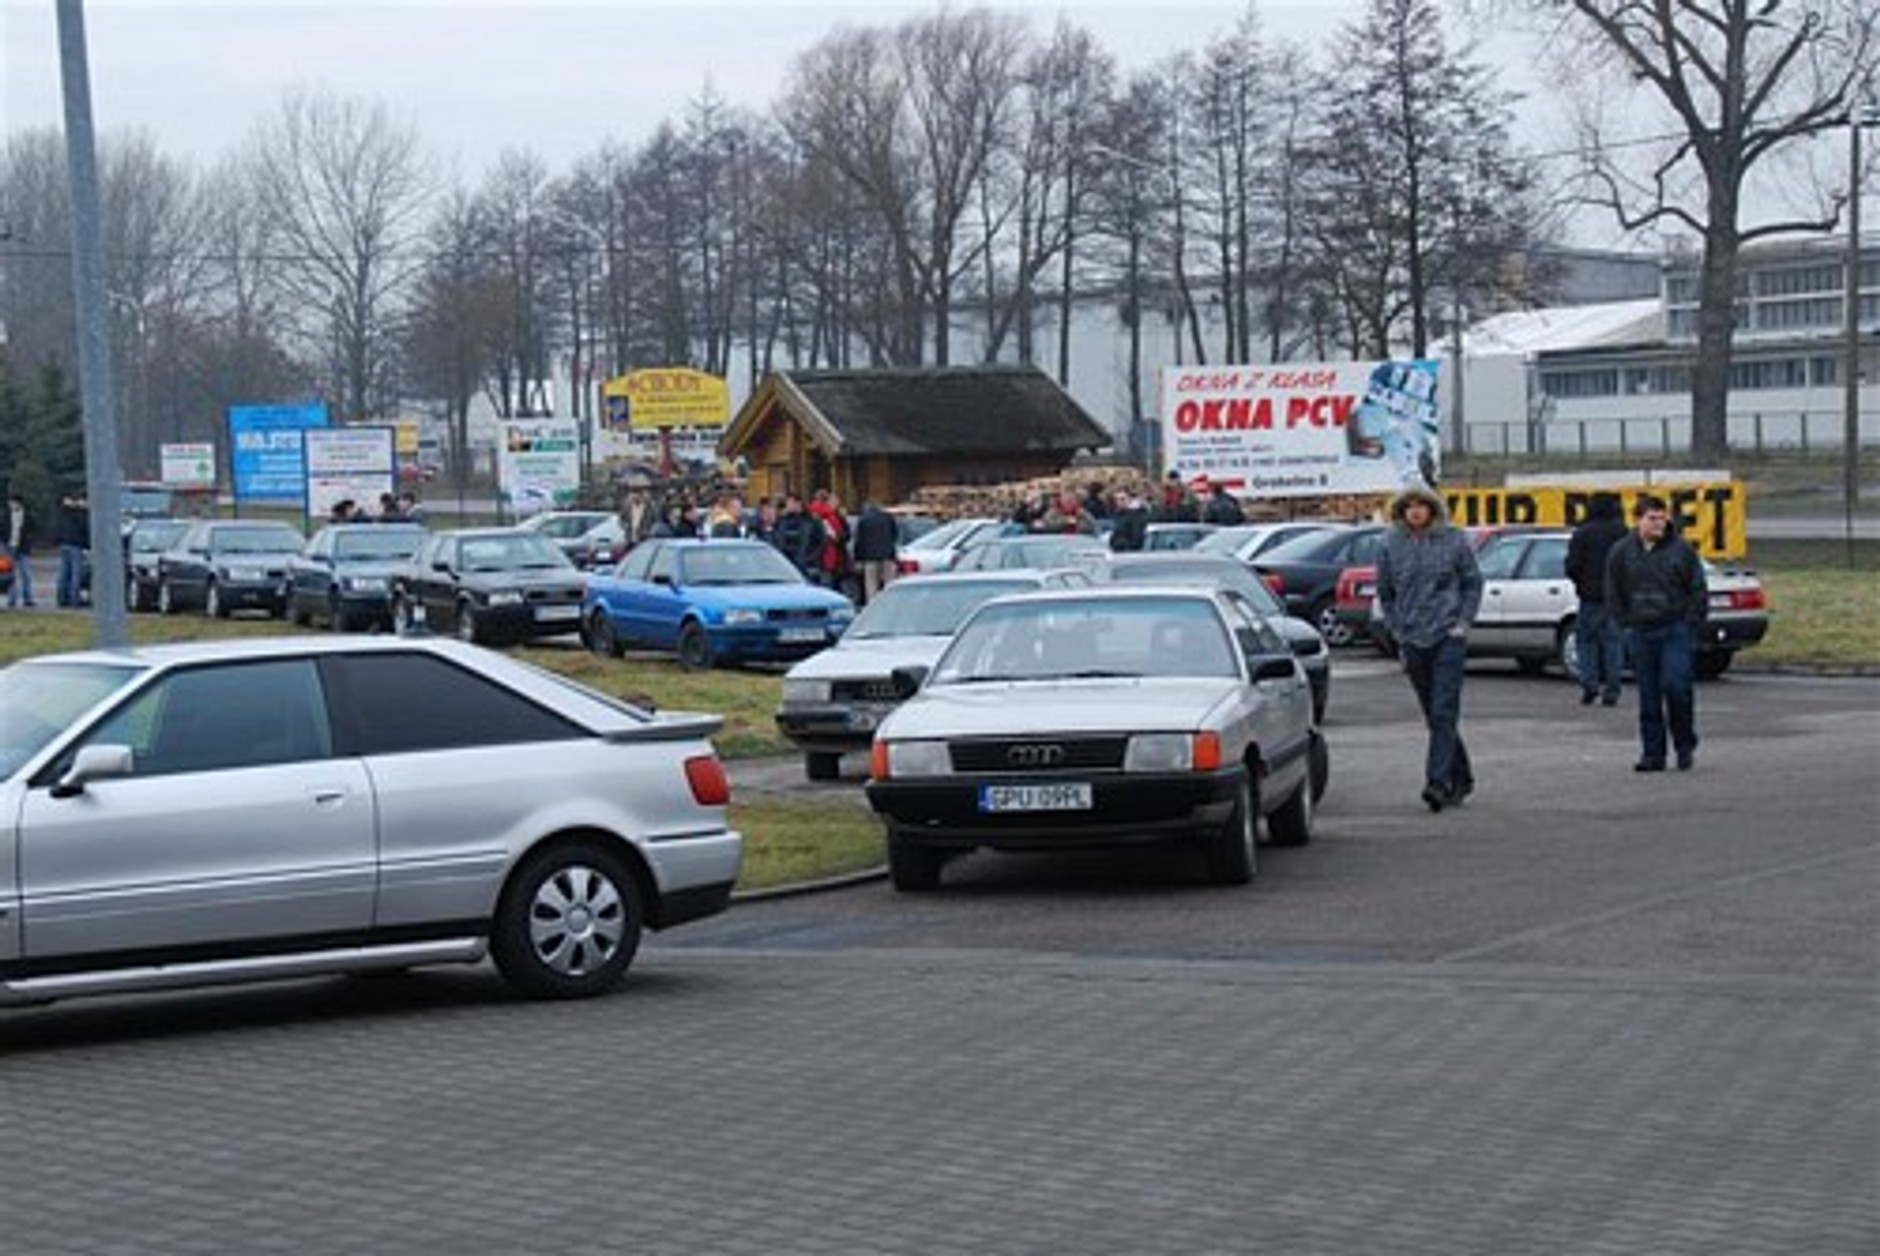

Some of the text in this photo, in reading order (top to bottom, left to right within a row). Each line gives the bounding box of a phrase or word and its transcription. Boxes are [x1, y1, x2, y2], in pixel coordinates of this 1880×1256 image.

[1177, 372, 1239, 392] OKNA
[1175, 394, 1356, 432] OKNA PCV
